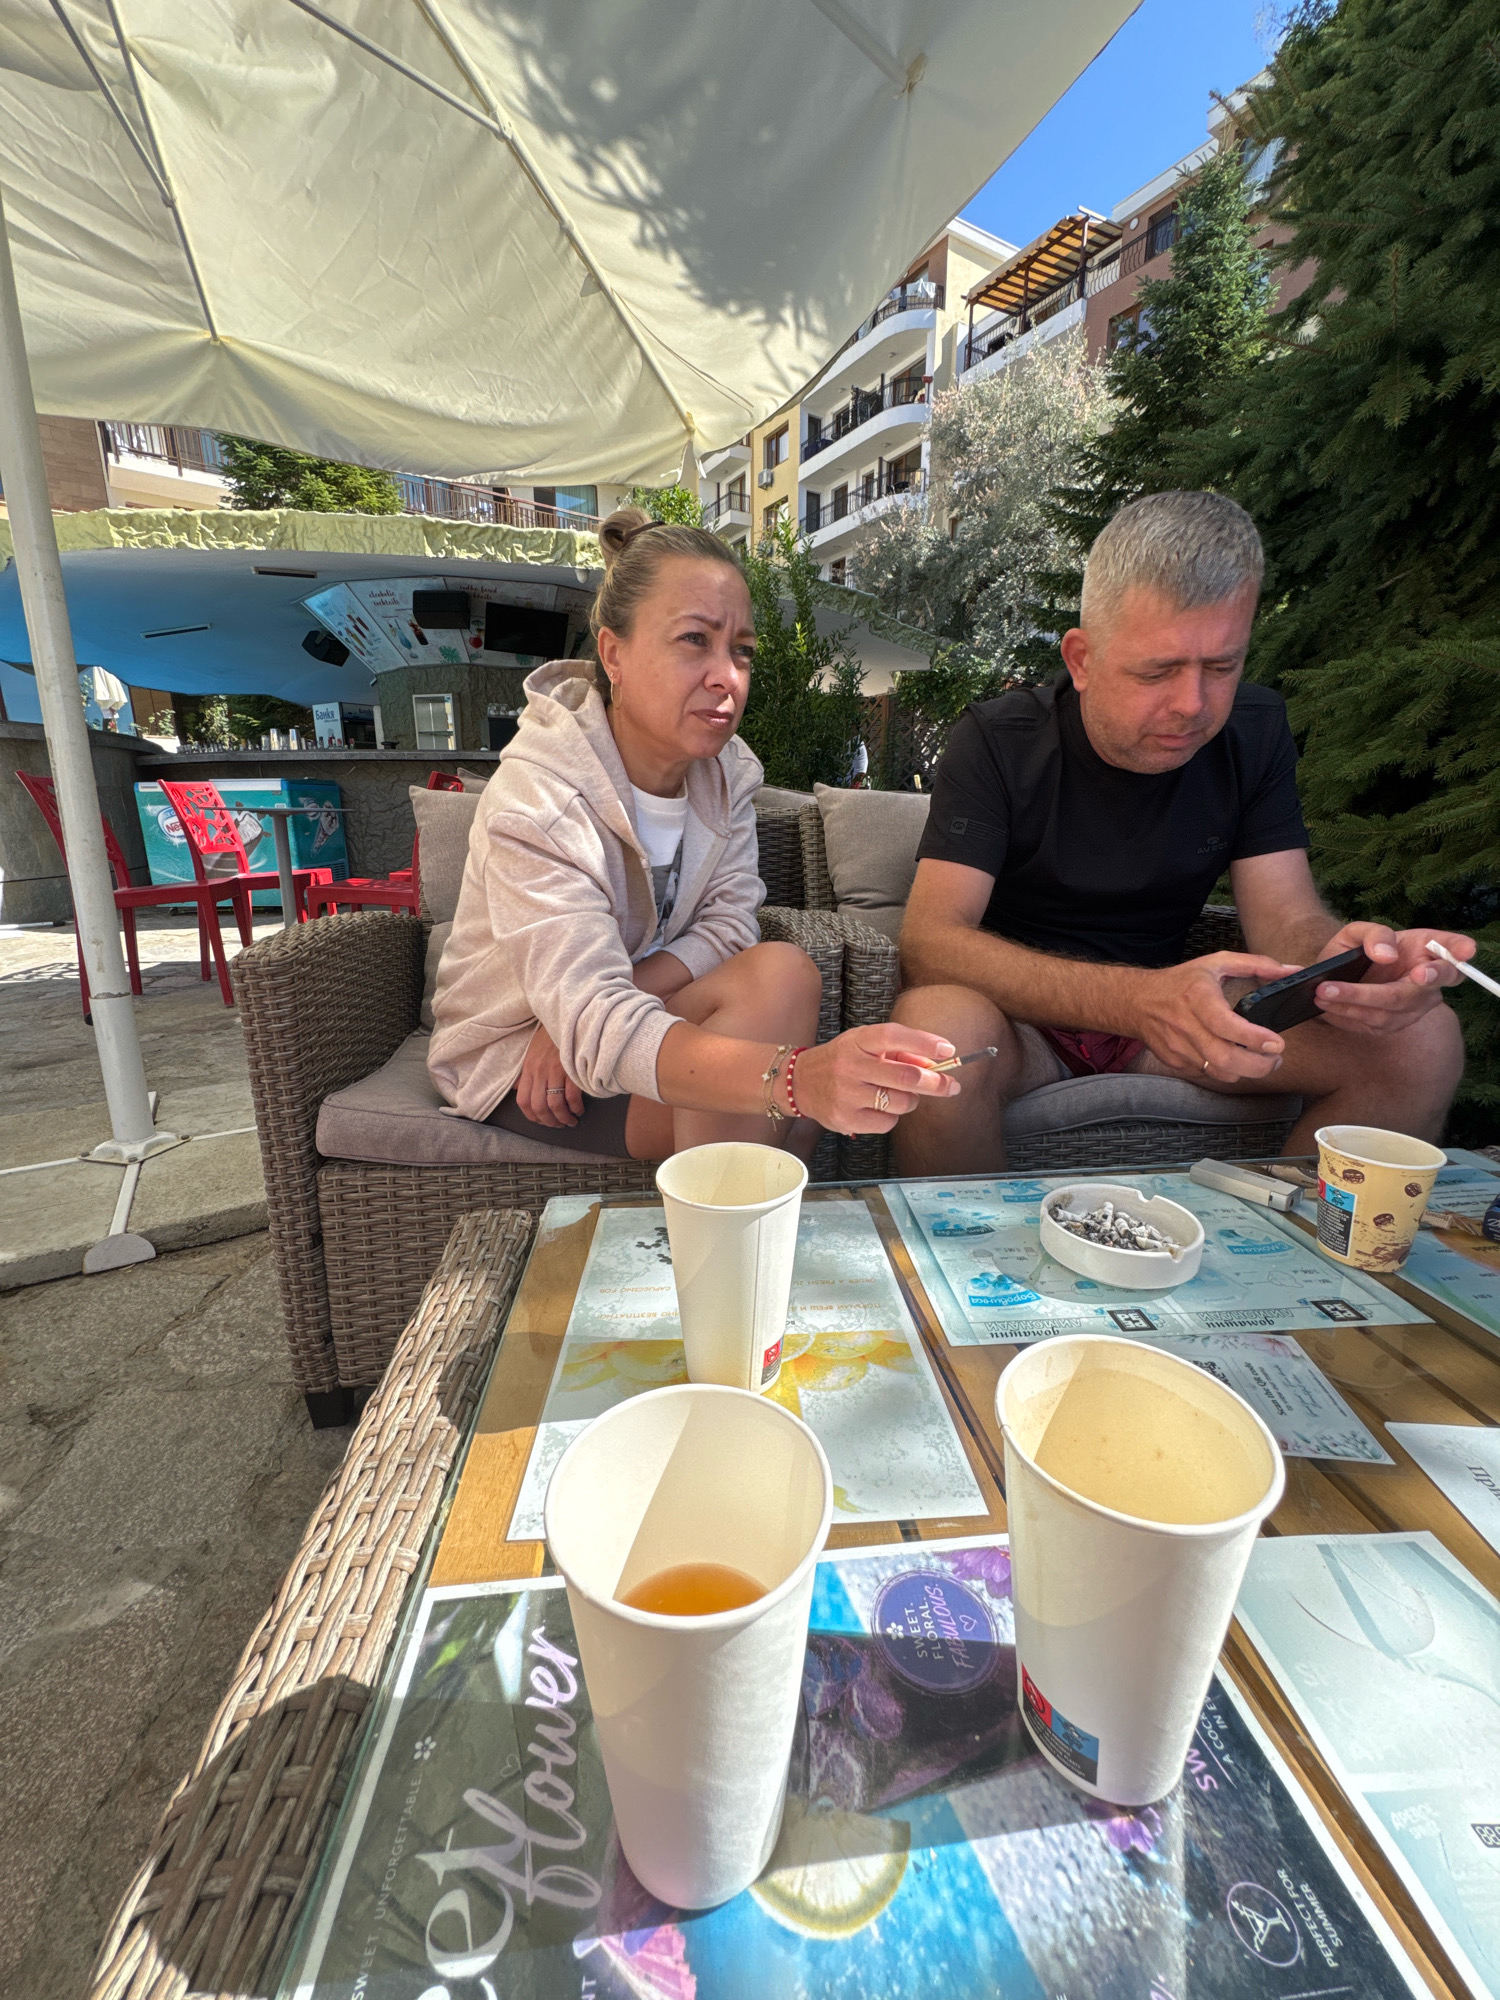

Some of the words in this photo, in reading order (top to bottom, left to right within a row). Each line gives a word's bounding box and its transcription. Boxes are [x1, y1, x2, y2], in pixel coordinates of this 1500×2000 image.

[369, 589, 395, 598] alcoholic
[374, 597, 400, 606] cocktails
[599, 1287, 617, 1295] FOR
[970, 1290, 1037, 1305] Боровинка
[1197, 1308, 1295, 1322] ЛИМОНАДИ
[983, 1317, 1080, 1332] ЛИМОНАДИ
[1205, 1316, 1275, 1330] домашни
[990, 1326, 1060, 1340] домашни
[1244, 1361, 1259, 1376] code
[1253, 1376, 1267, 1387] QR
[1262, 1387, 1275, 1399] the
[1271, 1399, 1287, 1416] Scan
[904, 1602, 928, 1658] SWEET.
[919, 1596, 945, 1660] FLORAL.
[924, 1583, 974, 1669] FABULOUS.
[1213, 1714, 1228, 1730] IN
[1222, 1753, 1234, 1765] A
[463, 1626, 602, 1909] flower
[373, 1772, 424, 1921] UNFORGETTABLE.
[1277, 1868, 1299, 1899] FOR
[1300, 1884, 1344, 1949] SUMMER
[1295, 1901, 1339, 1969] PERFECT
